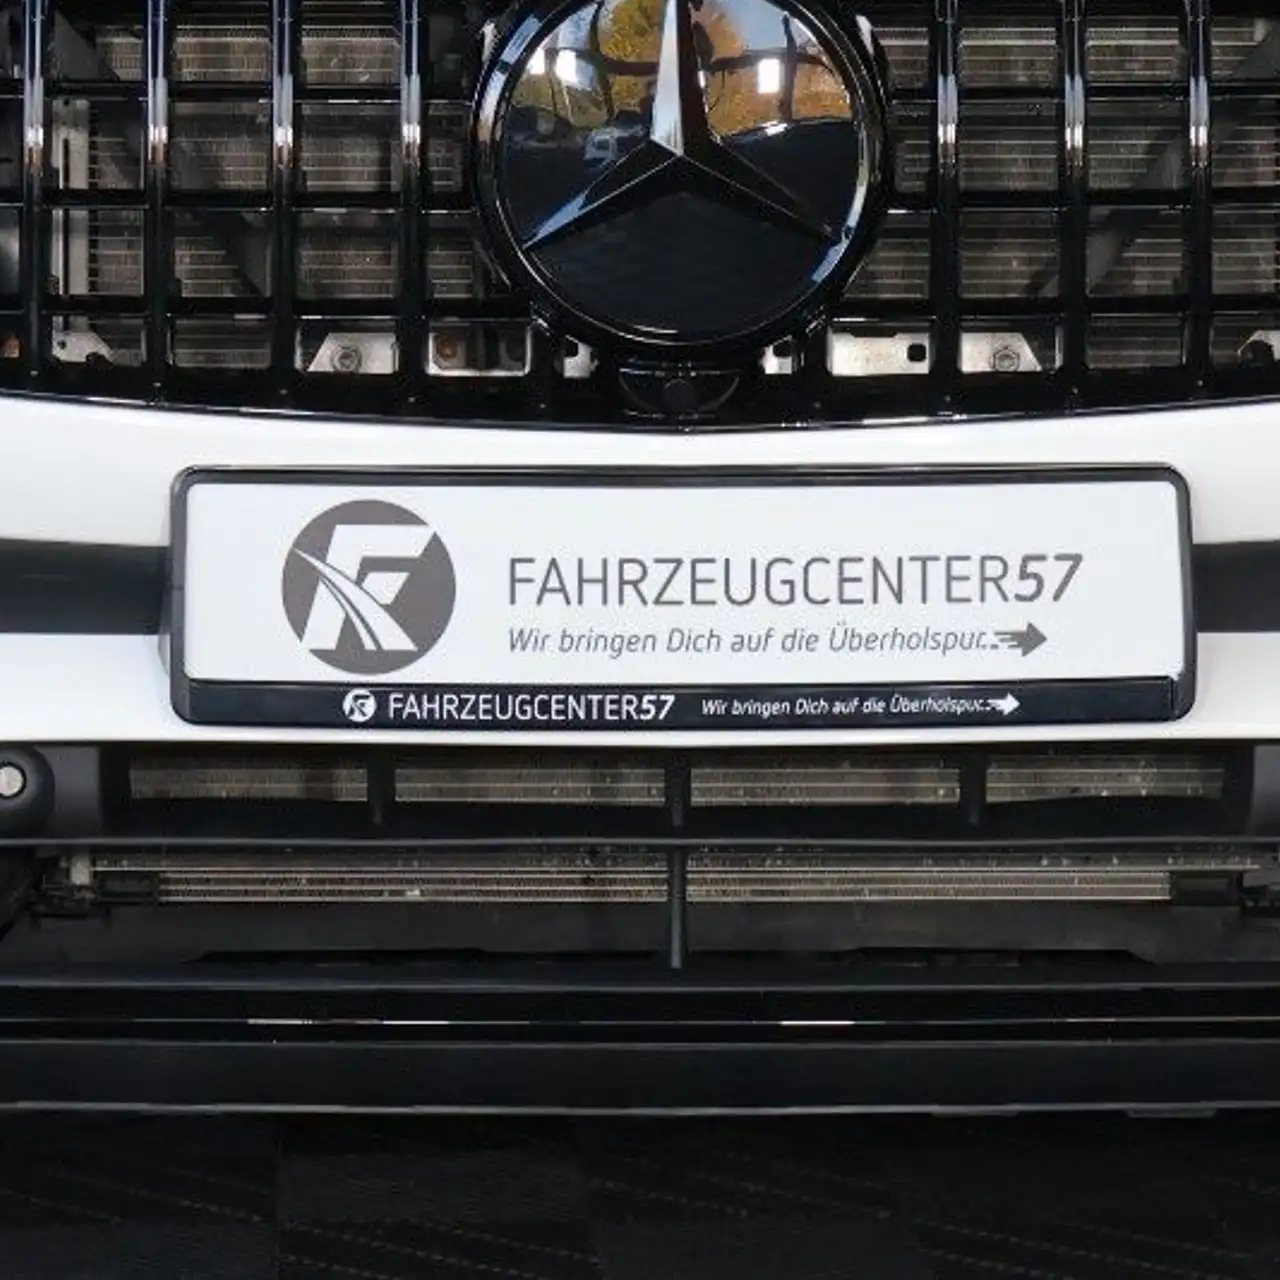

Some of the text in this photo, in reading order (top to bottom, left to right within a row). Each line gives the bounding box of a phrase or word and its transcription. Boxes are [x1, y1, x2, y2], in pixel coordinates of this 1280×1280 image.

[509, 554, 1083, 606] FAHRZEUGCENTER57
[509, 627, 551, 652] Wir
[558, 627, 656, 659] bringen
[666, 627, 720, 652] Dich
[730, 627, 775, 652] auf
[781, 627, 819, 651] die
[388, 693, 676, 720] FAHRZEUGCENTER57
[701, 699, 728, 716] Wir
[731, 699, 791, 719] bringen
[795, 697, 829, 715] Dich
[832, 697, 860, 715] auf
[862, 696, 887, 714] die
